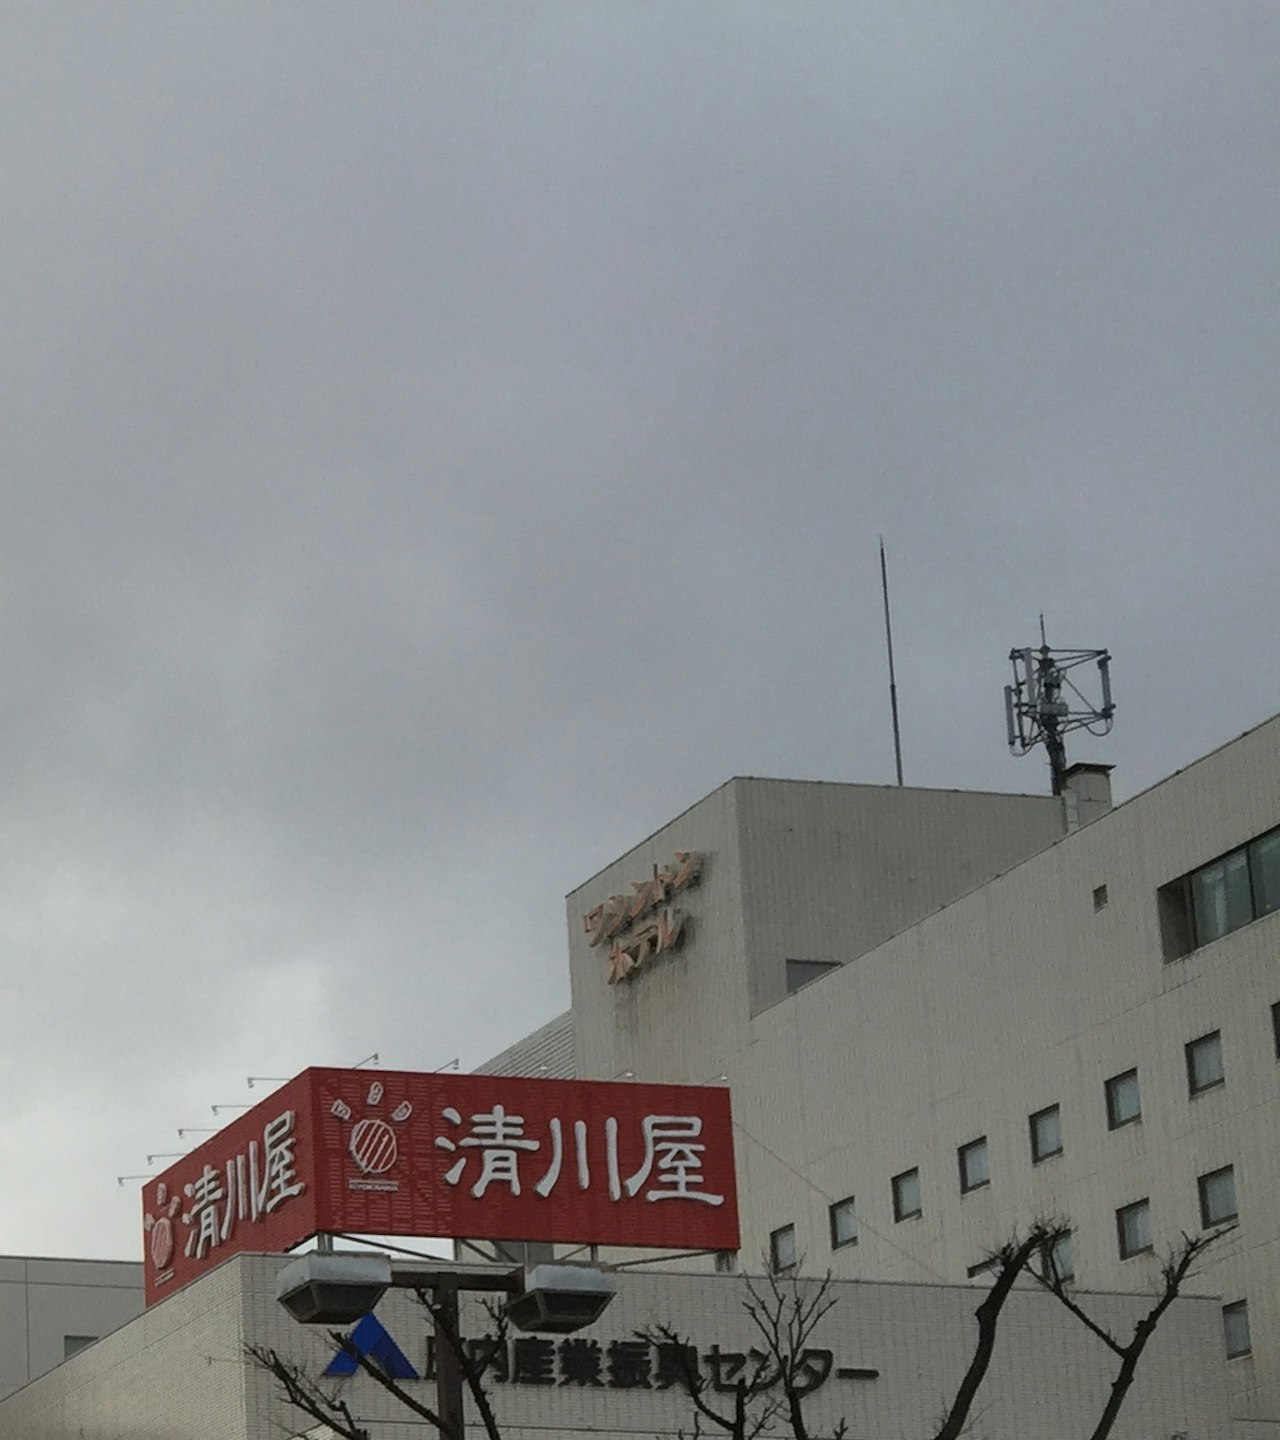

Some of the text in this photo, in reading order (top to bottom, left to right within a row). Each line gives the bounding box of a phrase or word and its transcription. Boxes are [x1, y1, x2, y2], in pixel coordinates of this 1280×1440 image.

[184, 1110, 306, 1260] 清川屋
[435, 1104, 724, 1205] 清川屋
